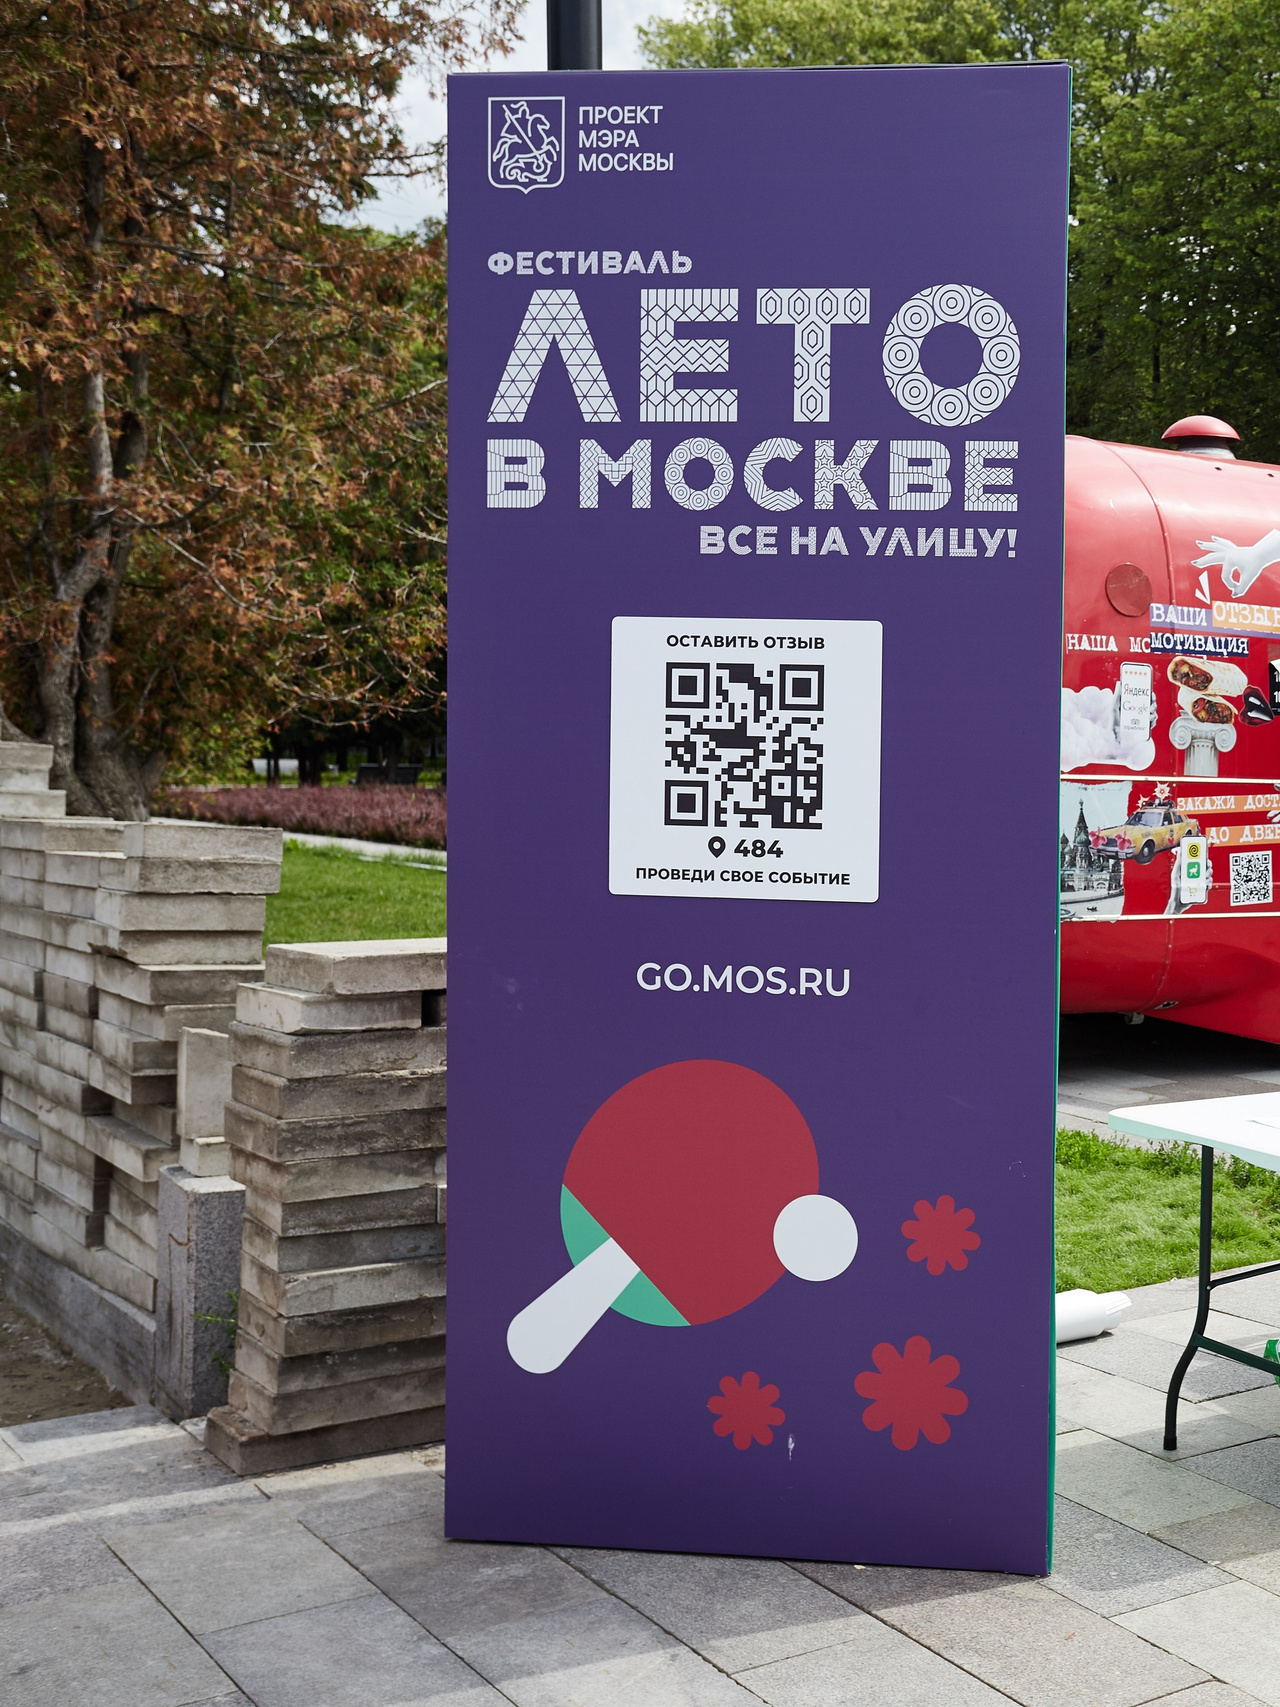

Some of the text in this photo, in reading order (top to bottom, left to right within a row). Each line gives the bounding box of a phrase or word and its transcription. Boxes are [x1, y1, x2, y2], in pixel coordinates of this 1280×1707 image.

[578, 106, 662, 125] ПРОЕКТ
[578, 130, 639, 149] МЭРА
[578, 153, 674, 171] МОСКВЫ
[487, 251, 692, 275] ФЕСТИВАЛЬ
[486, 283, 1021, 427] ЛЕТО
[486, 436, 1019, 512] В МОСКВЕ
[699, 525, 1018, 558] ВСЕ НА УЛИЦУ!
[1151, 603, 1207, 626] ВАШИ
[666, 635, 825, 650] ОСТАВИТЬ ОТЗЫВ
[1067, 634, 1118, 652] НАША
[1150, 632, 1249, 654] МОТИВАЦИЯ
[1123, 684, 1149, 697] Яндекс
[1122, 701, 1149, 714] Google
[1177, 795, 1235, 812] ЗАКАЖИ
[1208, 827, 1229, 844] ДО
[734, 839, 784, 858] 484
[636, 867, 851, 885] ПРОВЕДИ СВОЕ СОБЫТИЕ
[636, 962, 851, 997] GO.MOS.RU
